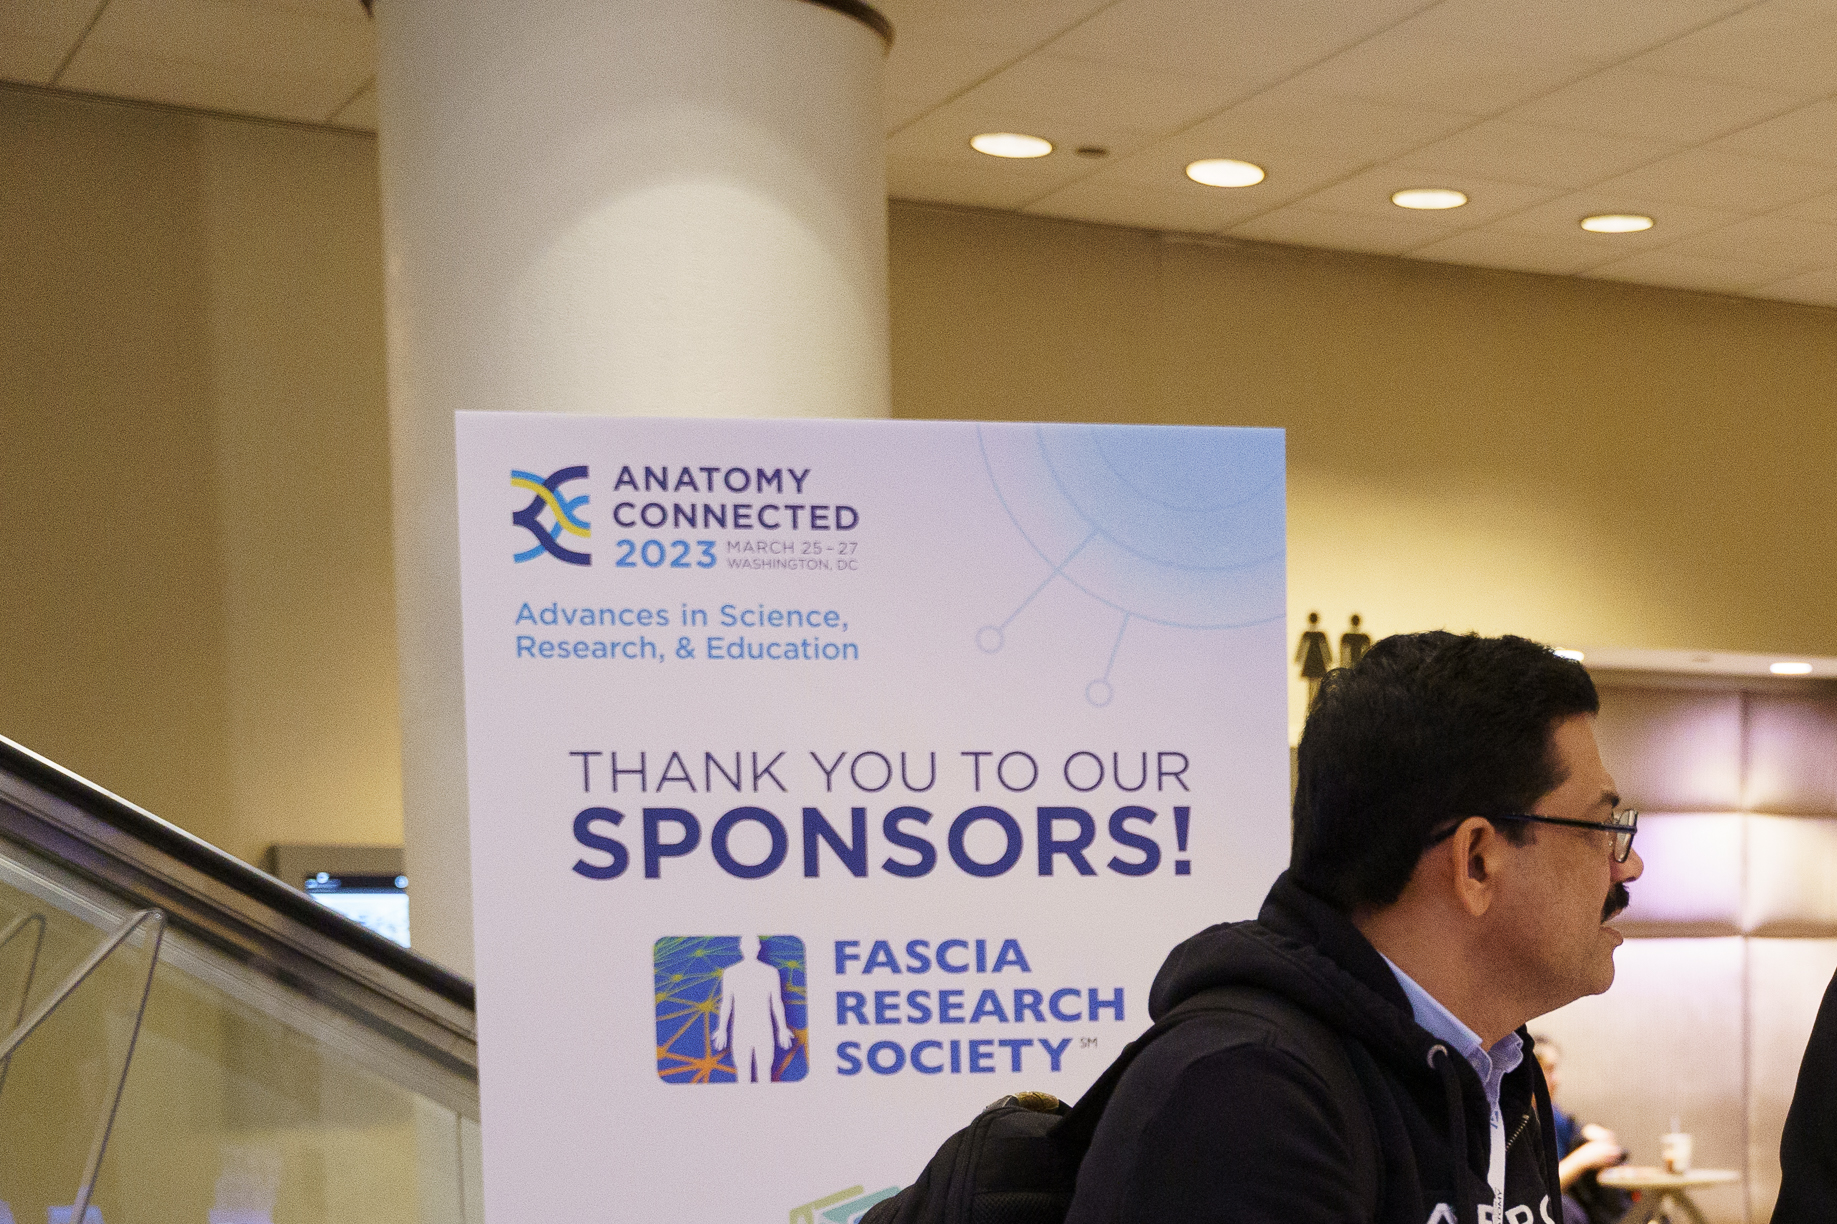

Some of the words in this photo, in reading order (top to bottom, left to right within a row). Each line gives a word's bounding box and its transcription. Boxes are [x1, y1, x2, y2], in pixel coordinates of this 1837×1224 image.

[613, 465, 811, 494] ANATOMY
[612, 501, 860, 531] CONNECTED
[615, 538, 718, 569] 2023
[726, 540, 795, 555] MARCH
[726, 557, 832, 572] WASHINGTON,
[836, 558, 858, 572] DC
[514, 601, 670, 627] Advances
[681, 602, 708, 627] in
[719, 603, 849, 632] Science,
[515, 634, 665, 663] Research,
[674, 635, 696, 660] &
[706, 635, 859, 661] Education
[568, 750, 788, 793] THANK
[809, 750, 937, 793] YOU
[960, 750, 1039, 793] TO
[1063, 750, 1190, 793] OUR
[571, 804, 1192, 881] SPONSORS!
[834, 938, 1032, 976] FASCIA
[835, 987, 1125, 1026] RESEARCH
[835, 1037, 1073, 1077] SOCIETY
